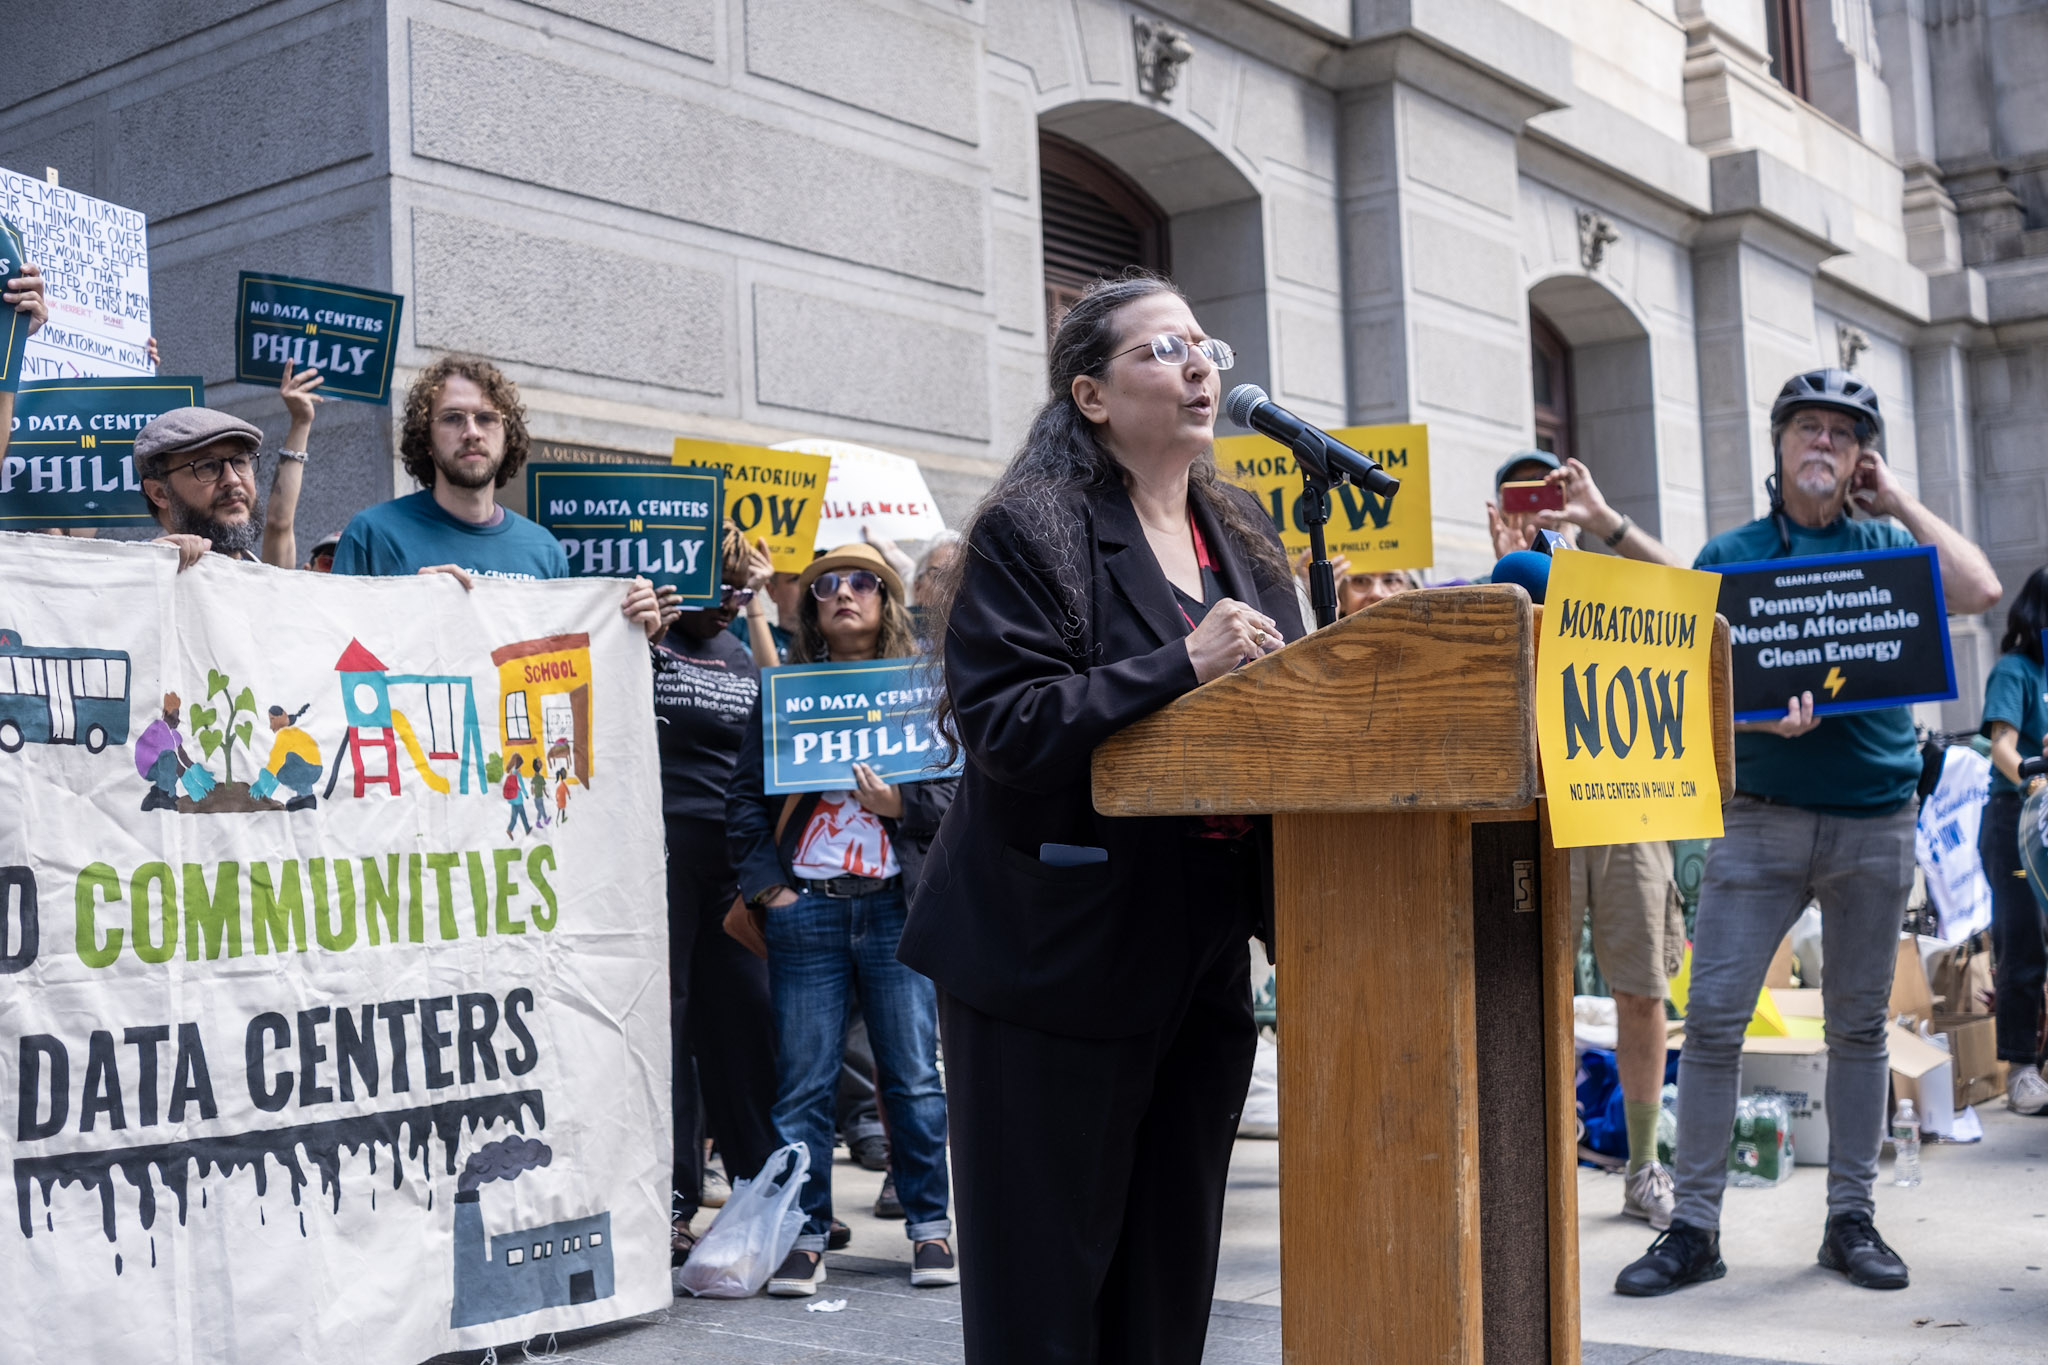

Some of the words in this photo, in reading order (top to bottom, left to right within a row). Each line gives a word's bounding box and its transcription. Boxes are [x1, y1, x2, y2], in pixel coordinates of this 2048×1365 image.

[38, 184, 76, 211] MEN
[81, 196, 143, 232] TURNED
[27, 199, 102, 239] THINKING
[108, 227, 146, 251] OVER
[54, 242, 94, 264] WOULD
[101, 257, 134, 277] SET
[69, 232, 80, 249] IN
[84, 236, 107, 256] THE
[112, 243, 147, 269] HOPE
[64, 260, 87, 277] BUT
[91, 267, 123, 287] THAT
[73, 288, 88, 305] TO
[95, 296, 149, 323] ENSLAVE
[86, 281, 122, 302] OTHER
[126, 291, 149, 311] MEN
[251, 301, 269, 314] NO
[273, 303, 310, 321] DATA
[314, 310, 383, 332] CENTERS
[306, 323, 317, 336] IN
[44, 323, 116, 361] MORATORIUM
[119, 345, 152, 371] NOW!
[252, 332, 375, 376] PHILLY
[21, 355, 63, 379] NITY
[28, 414, 83, 432] DATA
[90, 413, 163, 431] CENT
[81, 435, 96, 448] IN
[542, 446, 550, 458] A
[553, 447, 595, 464] QUEST
[0, 455, 142, 494] PHILL
[1236, 448, 1408, 478] MORAUM
[550, 500, 577, 516] NO
[584, 500, 632, 516] DATA
[637, 500, 708, 518] CENTERS
[724, 489, 810, 537] OW
[820, 500, 928, 519] ILLANCE!
[629, 519, 643, 533] IN
[1775, 574, 1806, 587] CLEAN
[1807, 572, 1822, 585] AIR
[1823, 569, 1864, 583] COUNCIL
[1749, 586, 1892, 617] Pennsylvania
[1558, 598, 1697, 649] MORATORIUM
[1730, 621, 1798, 645] Needs
[1803, 609, 1920, 638] Affordable
[1758, 647, 1822, 668] Clean
[1824, 640, 1902, 662] Energy
[524, 659, 578, 685] SCHOOL
[655, 694, 691, 707] Harm
[694, 695, 749, 715] Reduction
[656, 682, 693, 694] Youth
[694, 686, 744, 704] Programs
[785, 696, 814, 714] NO
[820, 692, 869, 711] DATA
[867, 710, 882, 722] IN
[1561, 662, 1688, 760] NOW
[1570, 782, 1583, 801] NO
[1585, 782, 1605, 801] DATA
[1607, 782, 1641, 800] CENTERS
[1642, 782, 1651, 799] IN
[1652, 781, 1675, 798] PHILLY
[1682, 781, 1697, 798] COM
[74, 844, 558, 969] COMMUNITIES
[17, 1022, 218, 1142] DATA
[245, 987, 541, 1113] CENTERS
